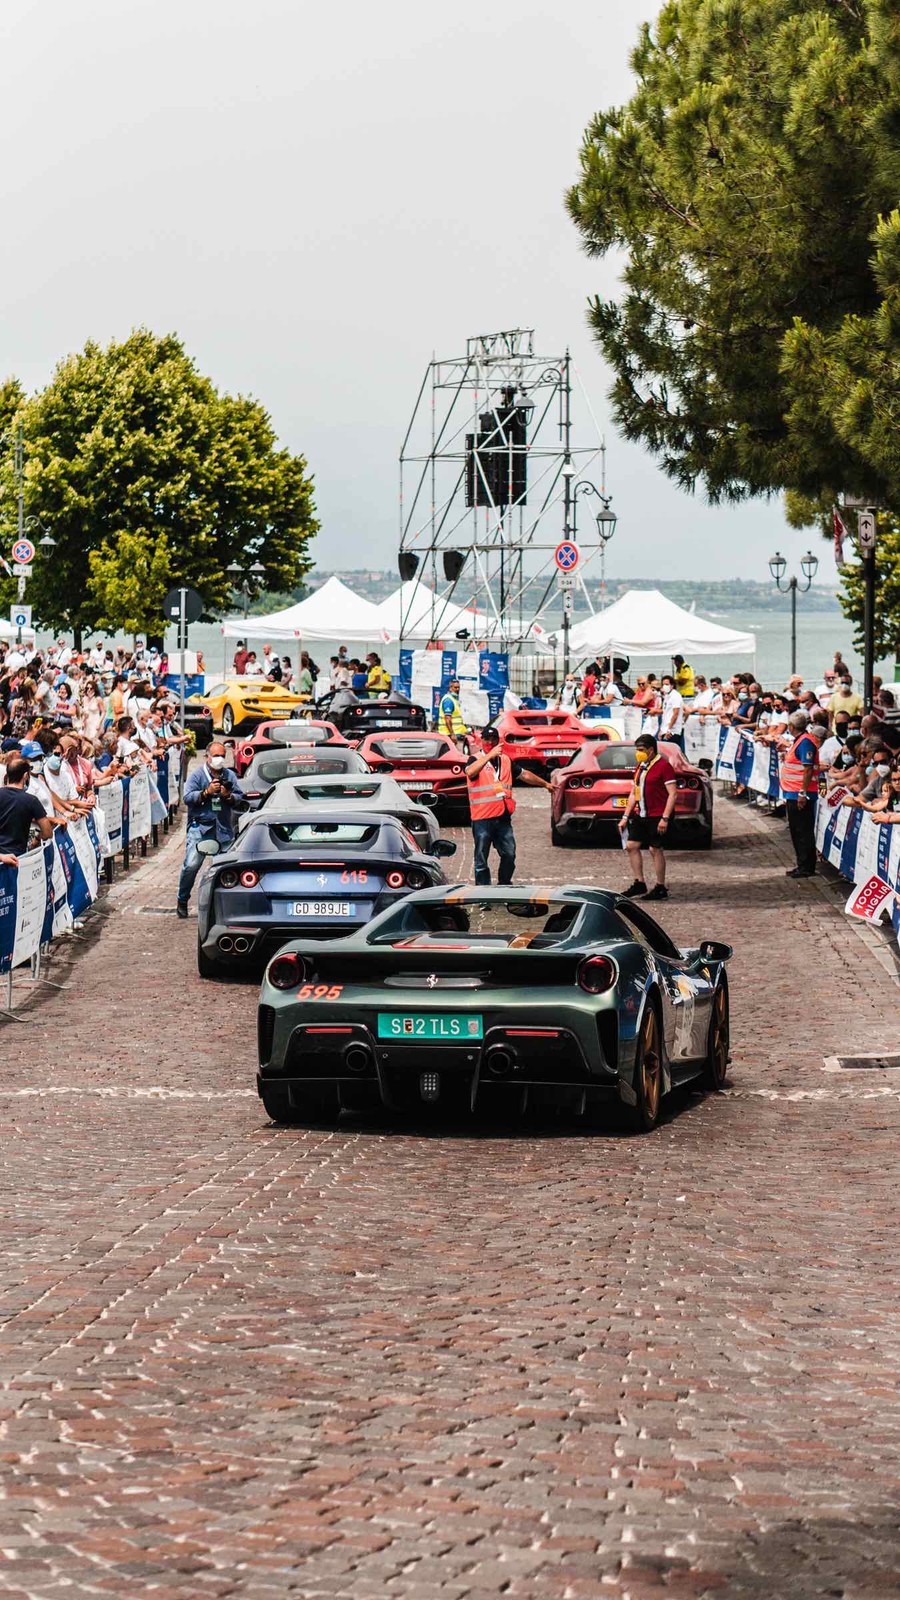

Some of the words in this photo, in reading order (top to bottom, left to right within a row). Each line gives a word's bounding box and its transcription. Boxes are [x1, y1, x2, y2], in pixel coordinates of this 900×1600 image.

[340, 870, 368, 885] 615
[855, 880, 879, 910] 1000
[863, 886, 891, 918] MIGLIA
[295, 902, 309, 915] GD
[315, 902, 348, 915] 989JE
[296, 985, 344, 1000] 595
[430, 1018, 460, 1034] TLS
